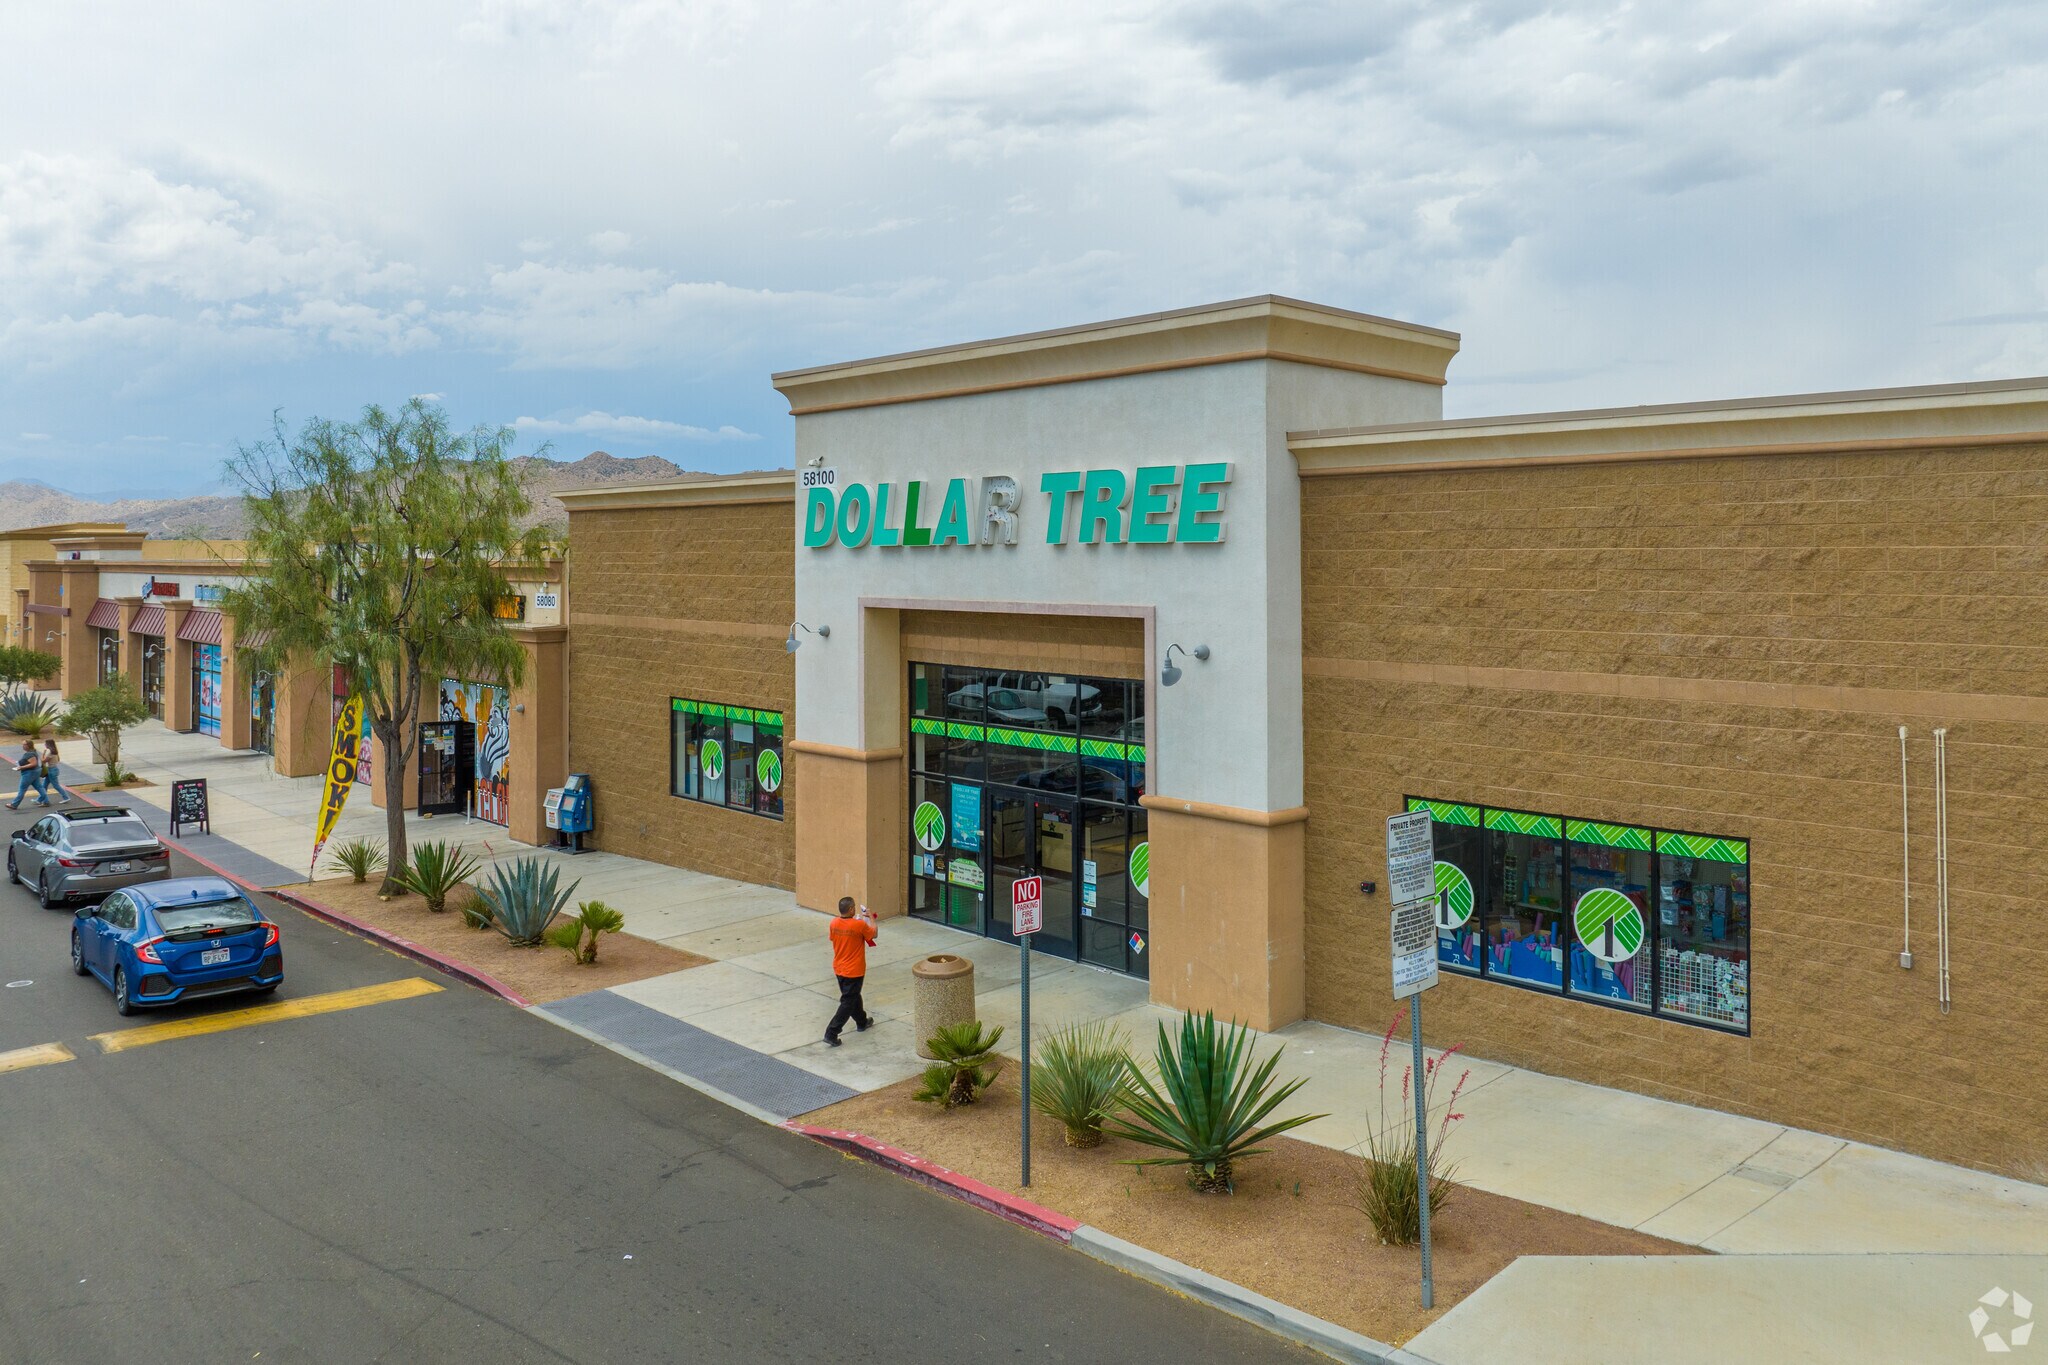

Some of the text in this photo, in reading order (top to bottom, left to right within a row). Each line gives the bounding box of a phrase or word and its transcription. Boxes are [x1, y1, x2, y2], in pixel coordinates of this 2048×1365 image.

[803, 470, 835, 486] 58100
[803, 463, 1234, 549] DOLLAR TREE
[537, 595, 556, 607] 58080
[1390, 816, 1429, 832] PRIVATE PROPERTY
[1017, 880, 1037, 902] NO
[1016, 901, 1039, 912] PARKING
[1021, 909, 1034, 918] FIRE
[1020, 917, 1034, 926] LANE
